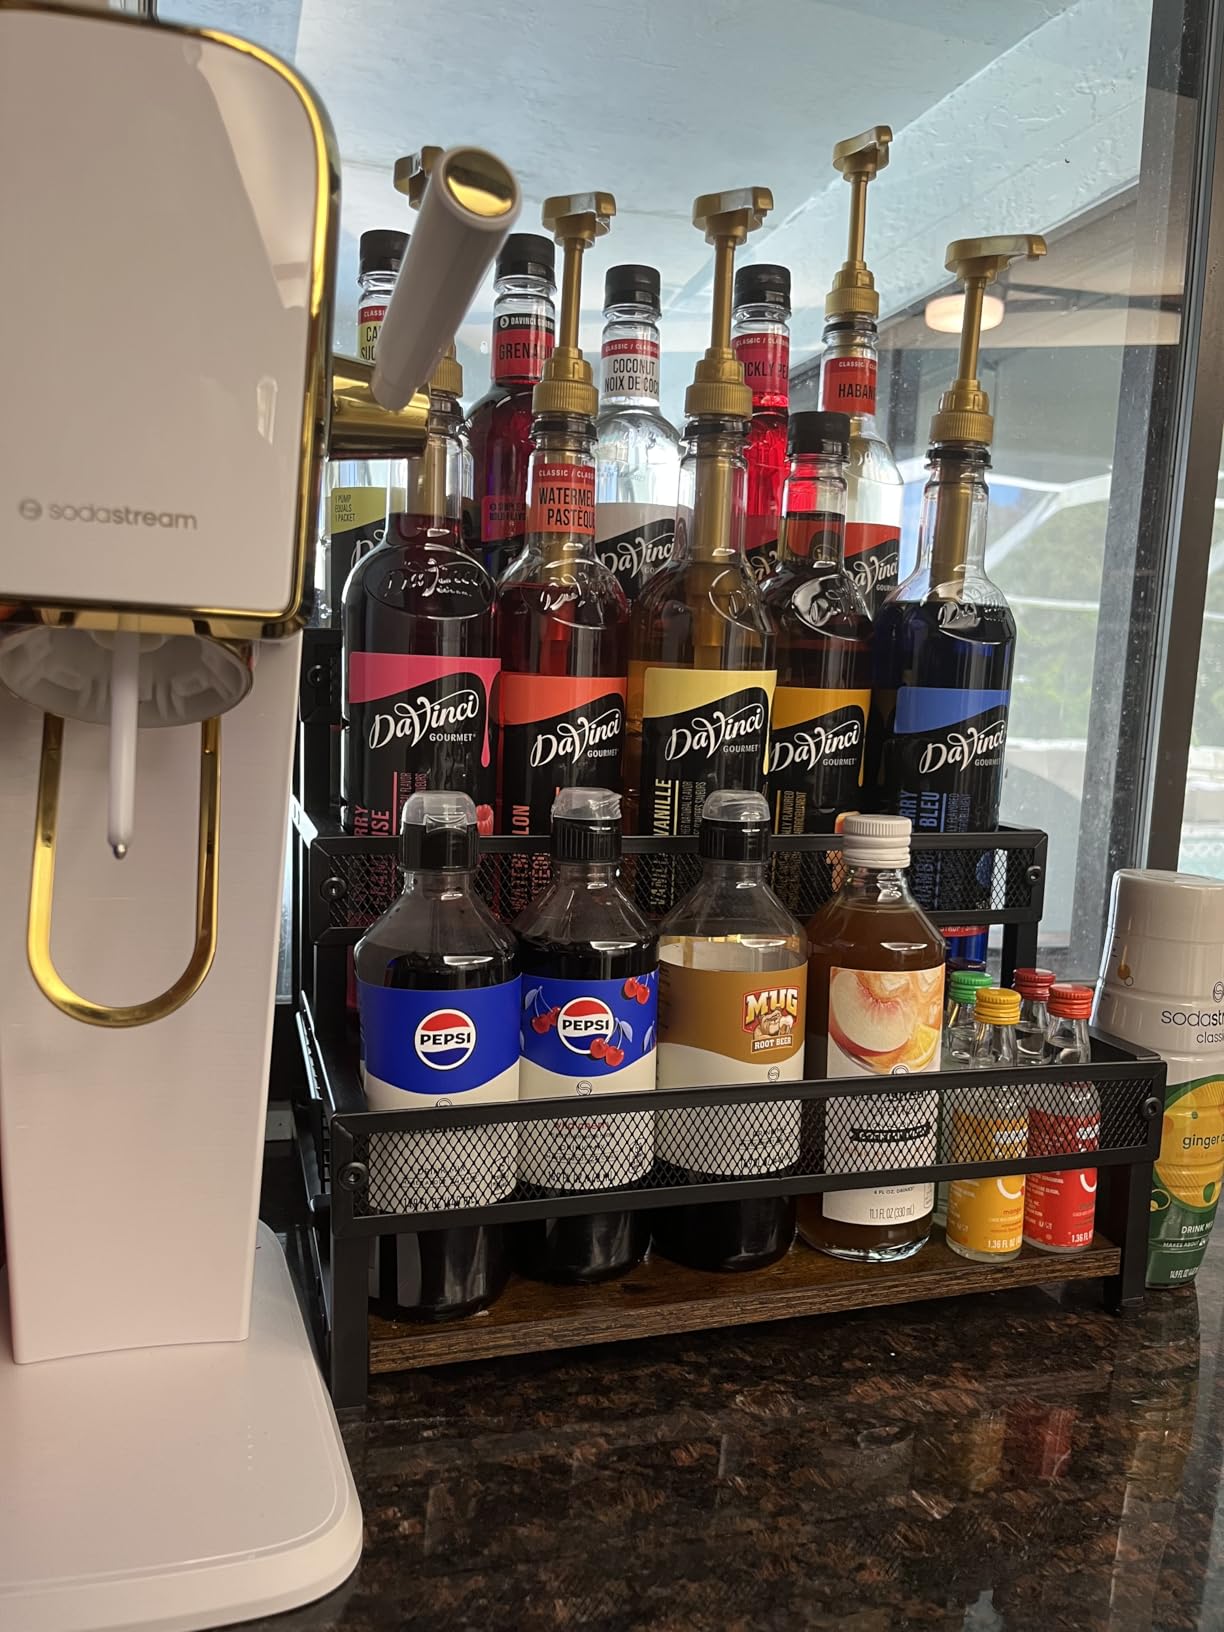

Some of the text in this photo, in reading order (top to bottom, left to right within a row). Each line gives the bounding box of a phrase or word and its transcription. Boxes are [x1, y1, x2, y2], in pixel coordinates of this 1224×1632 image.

[612, 358, 655, 376] COCONUT
[604, 375, 624, 392] NOIX
[628, 375, 640, 391] DE
[538, 469, 569, 477] CLASSIC
[49, 502, 199, 531] sodastream
[368, 689, 480, 750] DaVinci
[428, 732, 473, 743] GOURMET
[530, 708, 622, 768] DaVinci
[664, 703, 765, 761] DaVinci
[586, 748, 618, 758] GOURMET
[722, 743, 759, 753] GOURMET
[768, 719, 861, 773] DaVinci
[919, 719, 1006, 774] DaVinci
[822, 757, 856, 766] GOURMET
[653, 778, 672, 836] VANILLE
[919, 791, 940, 827] BLEU
[745, 988, 798, 1025] MUG
[562, 1019, 609, 1031] PEPSI
[420, 1032, 471, 1046] PEPSI
[754, 1036, 792, 1050] ROOT BEER
[1182, 1134, 1219, 1150] ginger
[1181, 1223, 1205, 1235] DRINK
